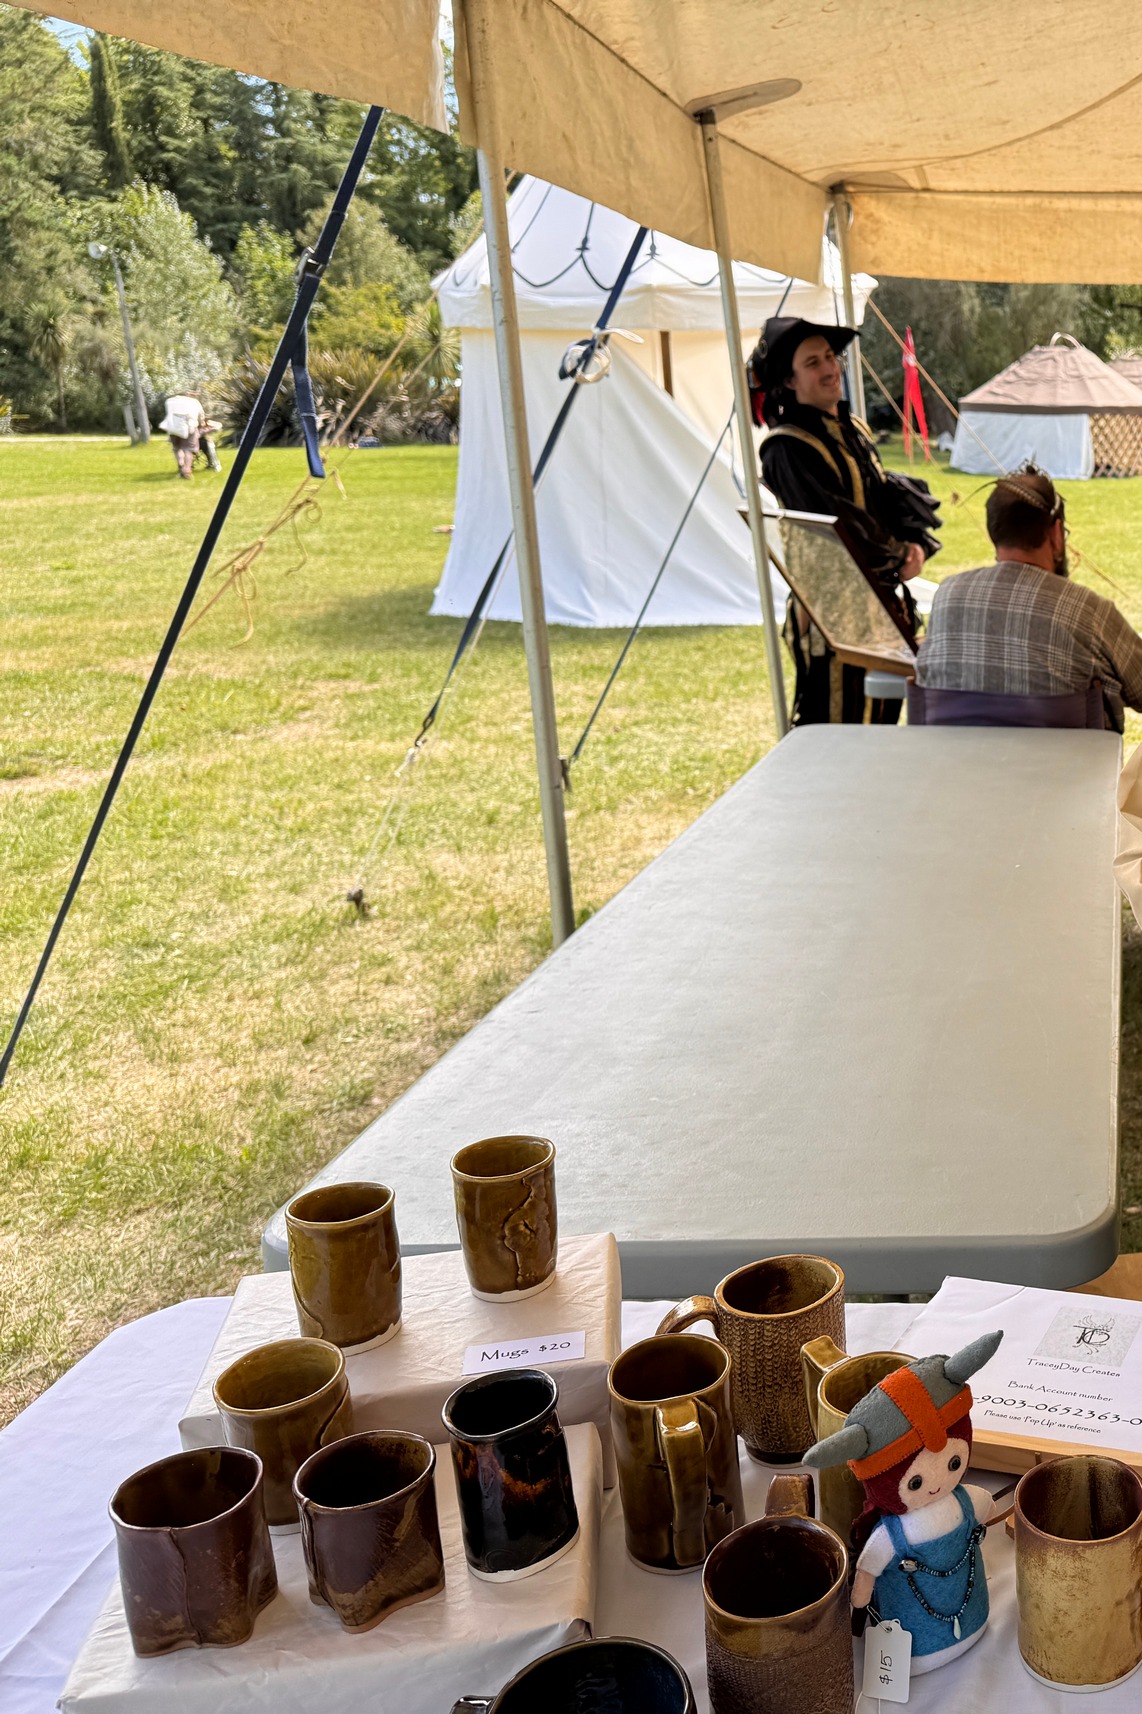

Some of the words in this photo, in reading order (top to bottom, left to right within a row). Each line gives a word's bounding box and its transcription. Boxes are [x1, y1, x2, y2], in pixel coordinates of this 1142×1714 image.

[480, 1349, 529, 1362] Mugs
[538, 1341, 571, 1353] $20
[1081, 1365, 1121, 1377] Creates
[1008, 1380, 1034, 1391] Bank
[1034, 1385, 1077, 1397] Account
[1078, 1393, 1113, 1402] number
[983, 1409, 1008, 1419] Please
[1066, 1423, 1101, 1434] reference
[878, 1650, 893, 1685] $15
